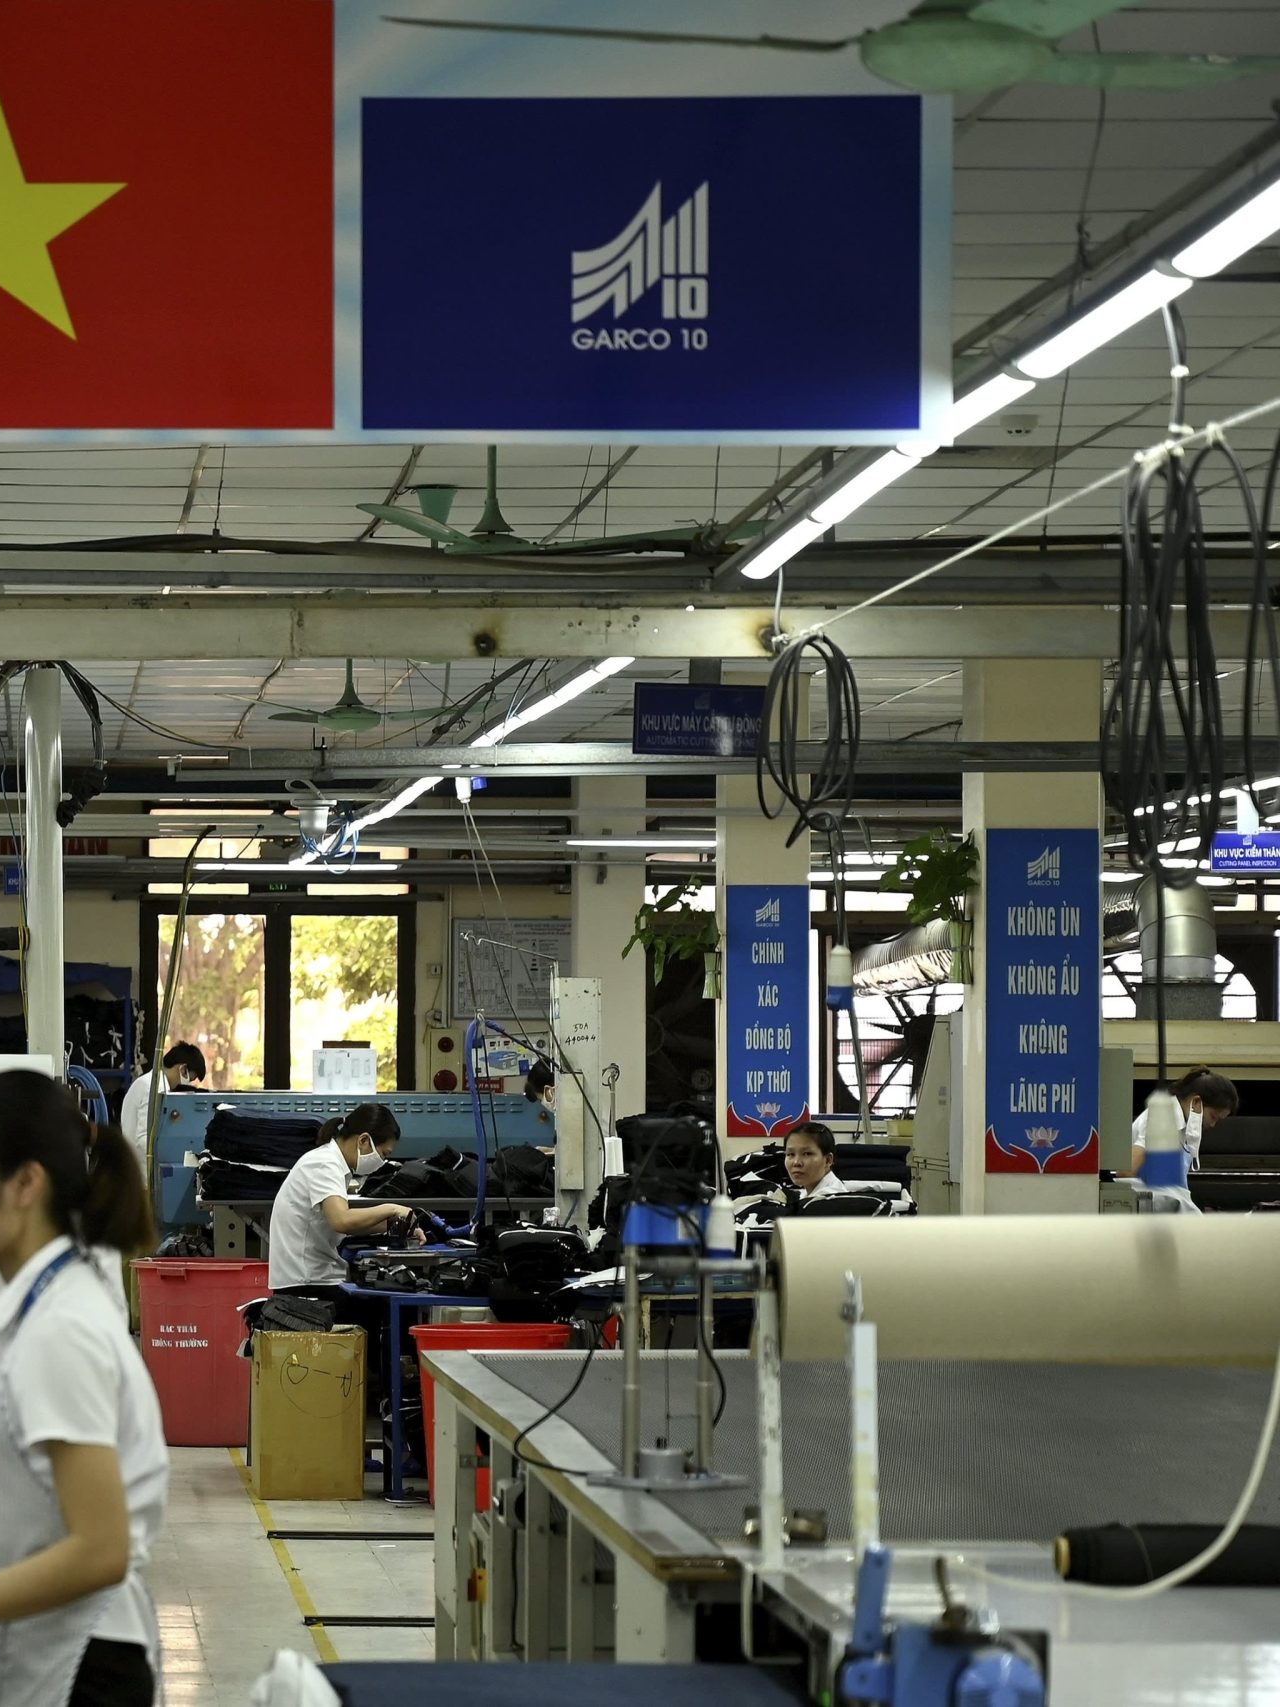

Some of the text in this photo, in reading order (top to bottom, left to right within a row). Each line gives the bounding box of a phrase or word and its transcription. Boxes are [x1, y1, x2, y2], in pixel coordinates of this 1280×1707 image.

[572, 328, 709, 350] GARCO 10
[642, 715, 660, 731] KHU
[1214, 848, 1227, 858] KHU
[1245, 844, 1262, 857] KIỂM
[1008, 900, 1080, 936] KHÔNG ÙN
[752, 938, 784, 964] CHÍNH
[1008, 959, 1056, 995] KHÔNG
[758, 980, 779, 1007] XÁC
[777, 1023, 791, 1055] BỘ
[1019, 1018, 1068, 1055] KHÔNG
[746, 1065, 791, 1098] KỊP THỜI
[1010, 1077, 1076, 1113] LÃNG PHÍ
